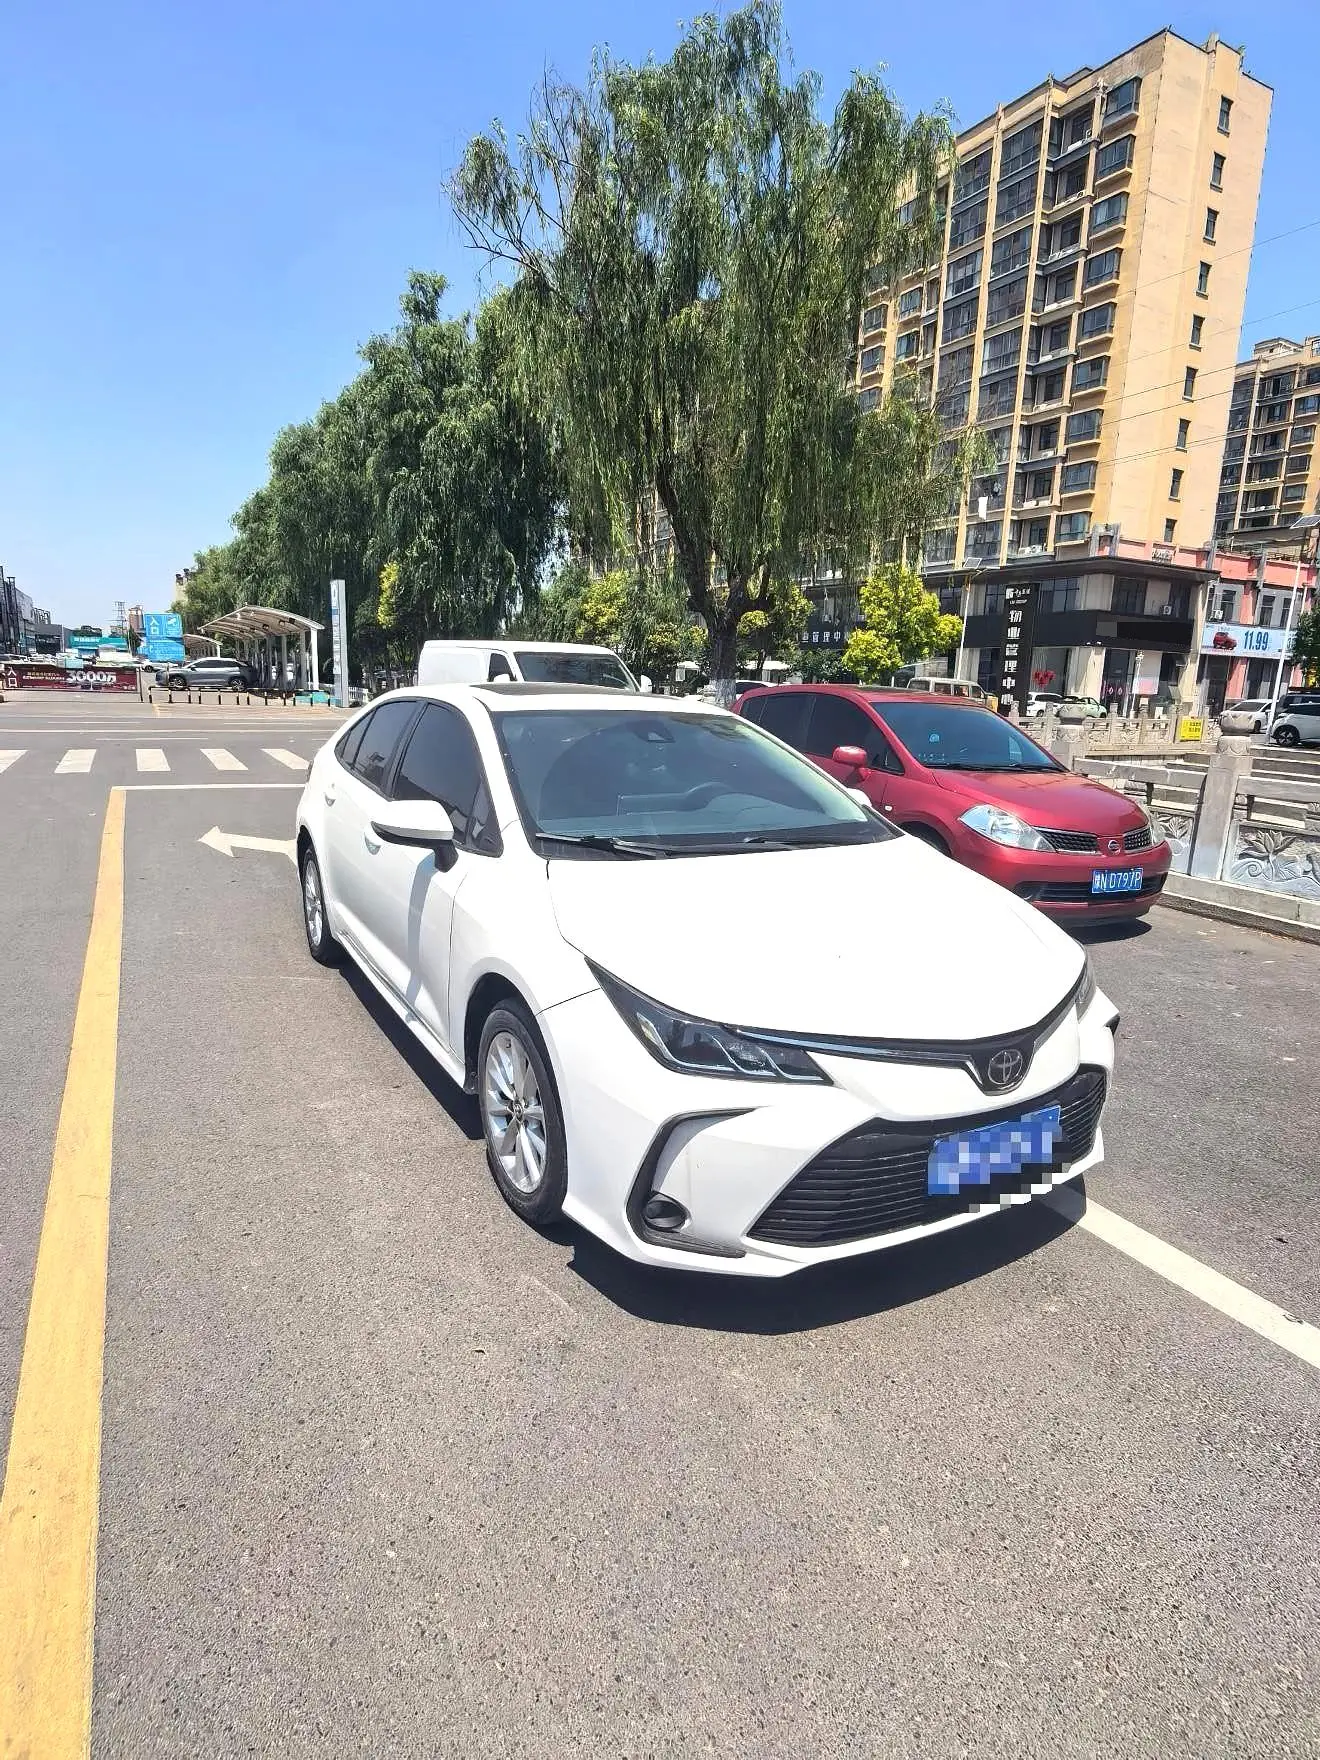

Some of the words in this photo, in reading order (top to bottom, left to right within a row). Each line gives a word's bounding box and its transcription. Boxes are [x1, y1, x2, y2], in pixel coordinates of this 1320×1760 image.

[150, 616, 161, 635] 入口
[1244, 631, 1269, 651] 11.99
[1001, 610, 1023, 705] 物业管理中心
[8, 667, 18, 688] 入口
